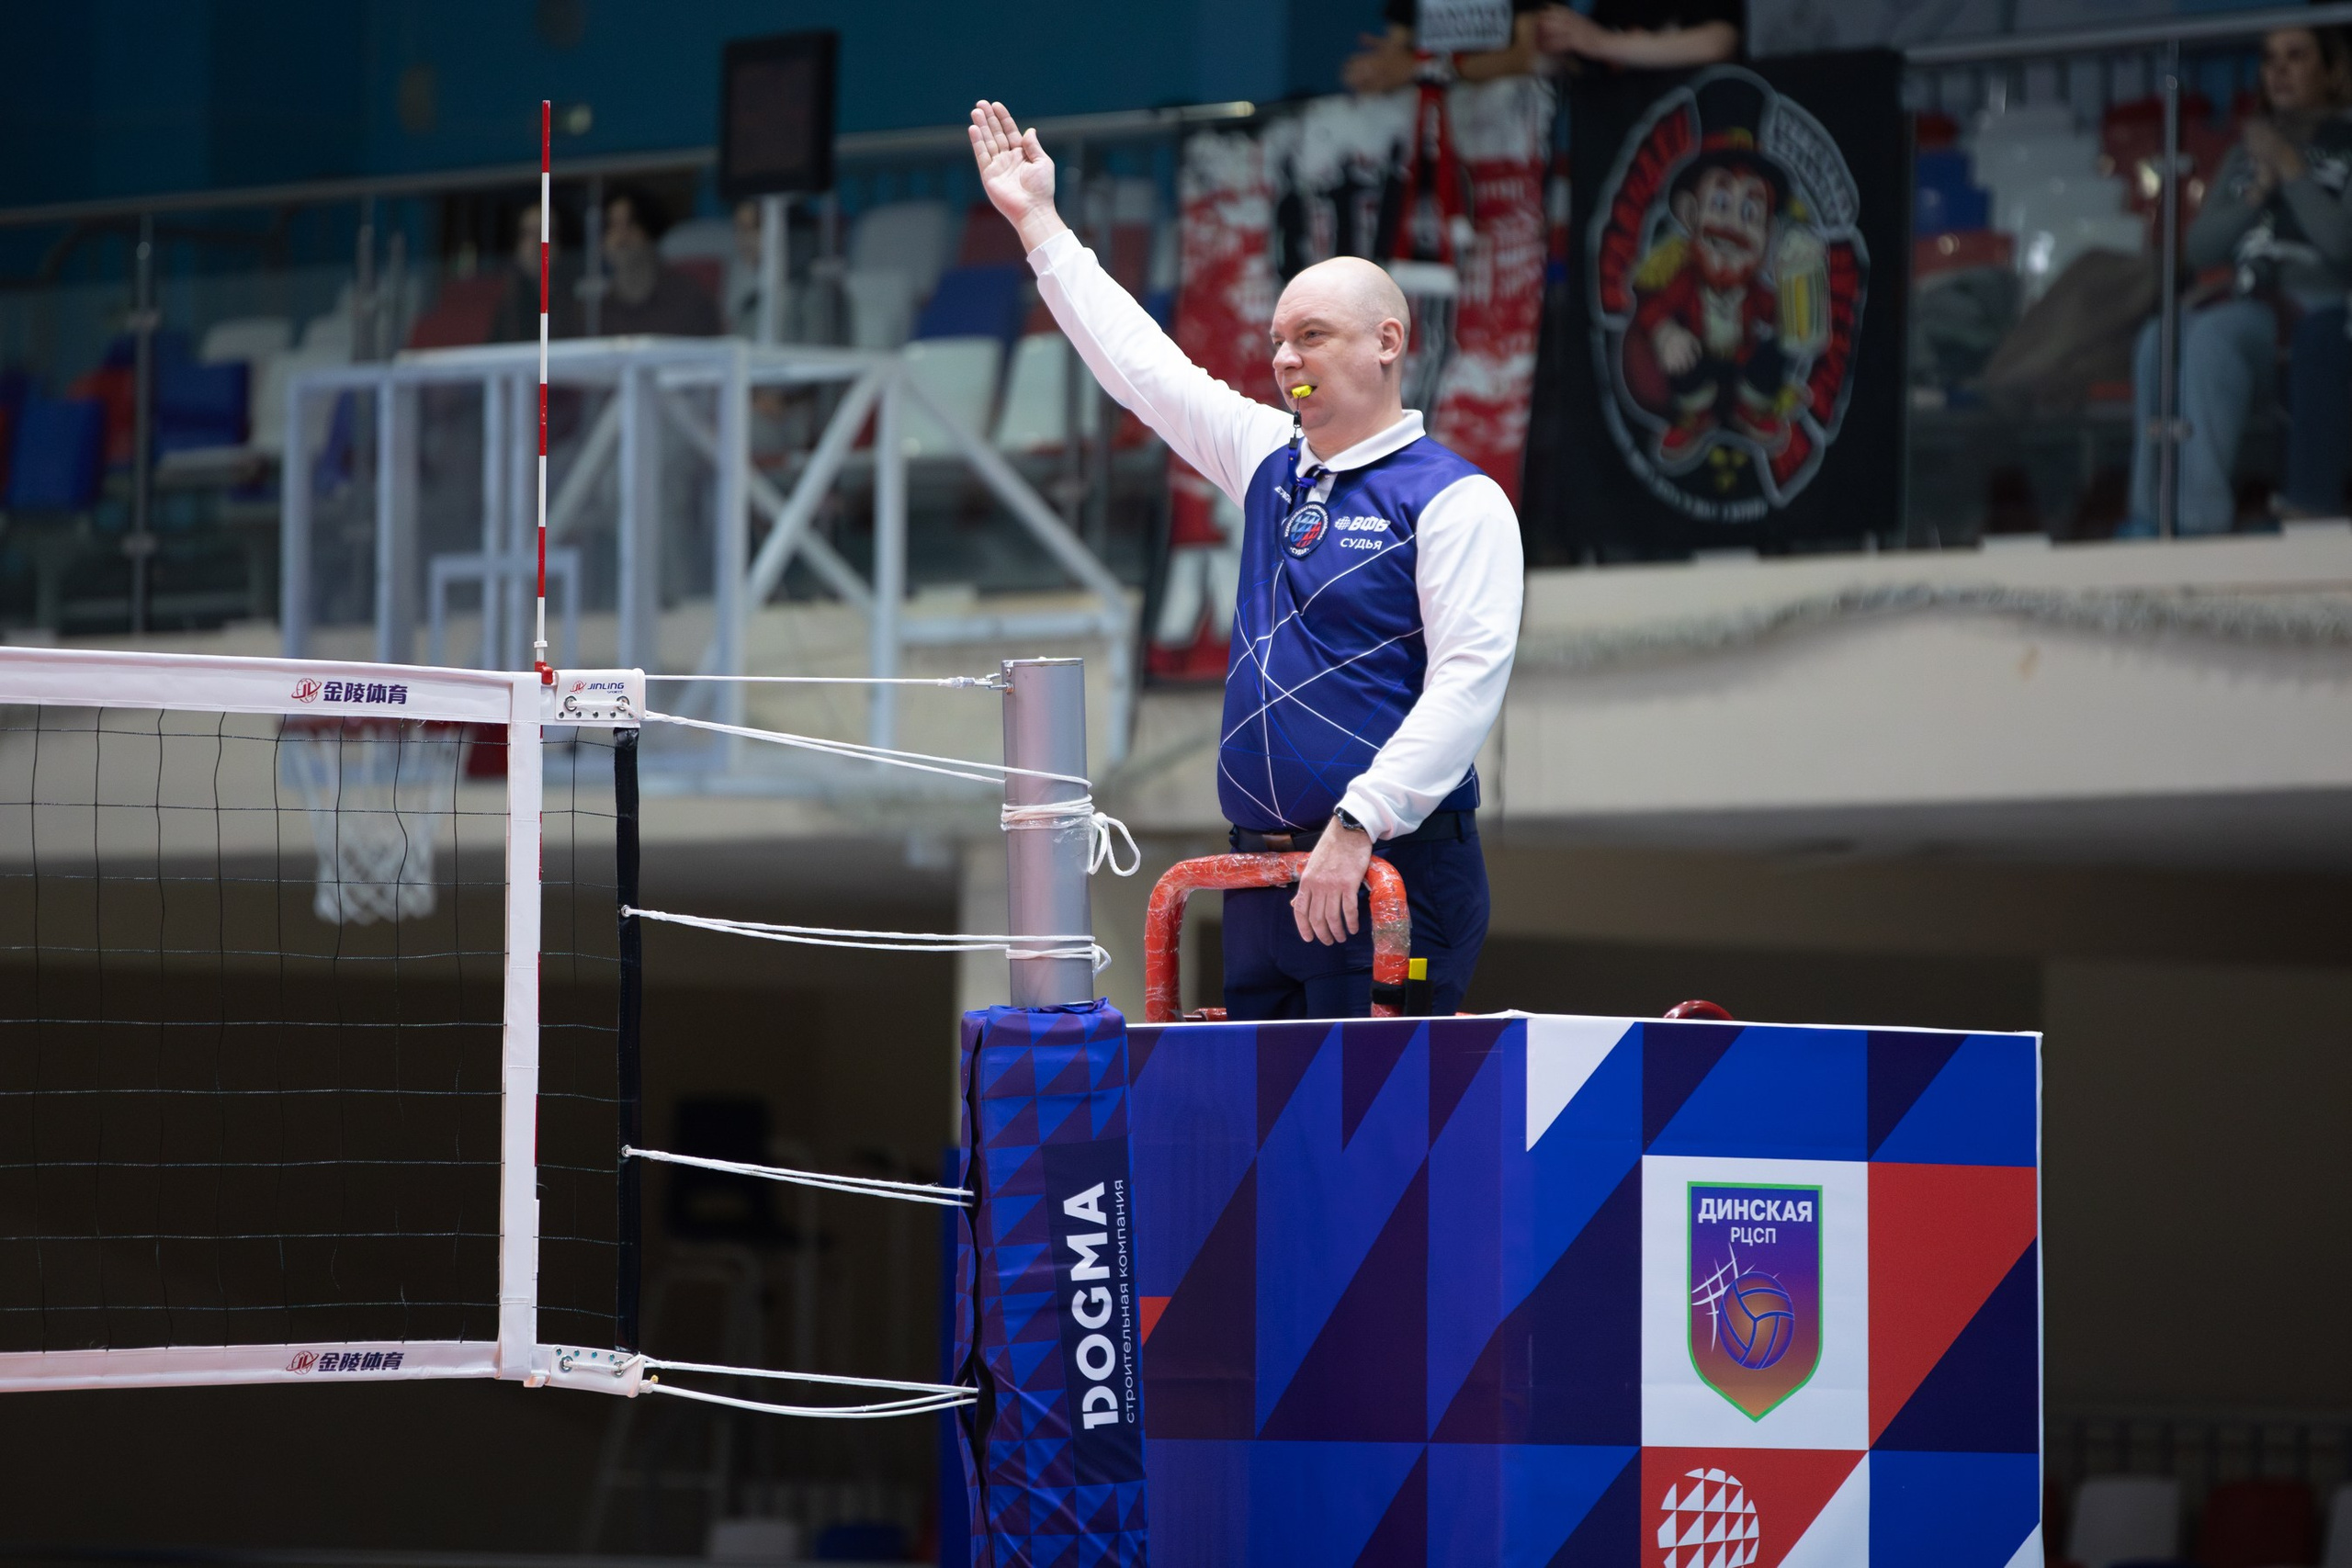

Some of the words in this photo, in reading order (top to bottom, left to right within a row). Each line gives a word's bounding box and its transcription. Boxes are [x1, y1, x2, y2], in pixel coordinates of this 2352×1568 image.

[1340, 538, 1383, 550] СУДЬЯ
[323, 681, 408, 705] 金陵体育
[1698, 1198, 1813, 1224] ДИНСКАЯ
[1114, 1179, 1128, 1277] компания
[1730, 1226, 1777, 1247] РЦСП
[1063, 1181, 1119, 1429] DOGMA
[318, 1351, 404, 1371] 金陵体育
[1119, 1283, 1136, 1424] строительная
